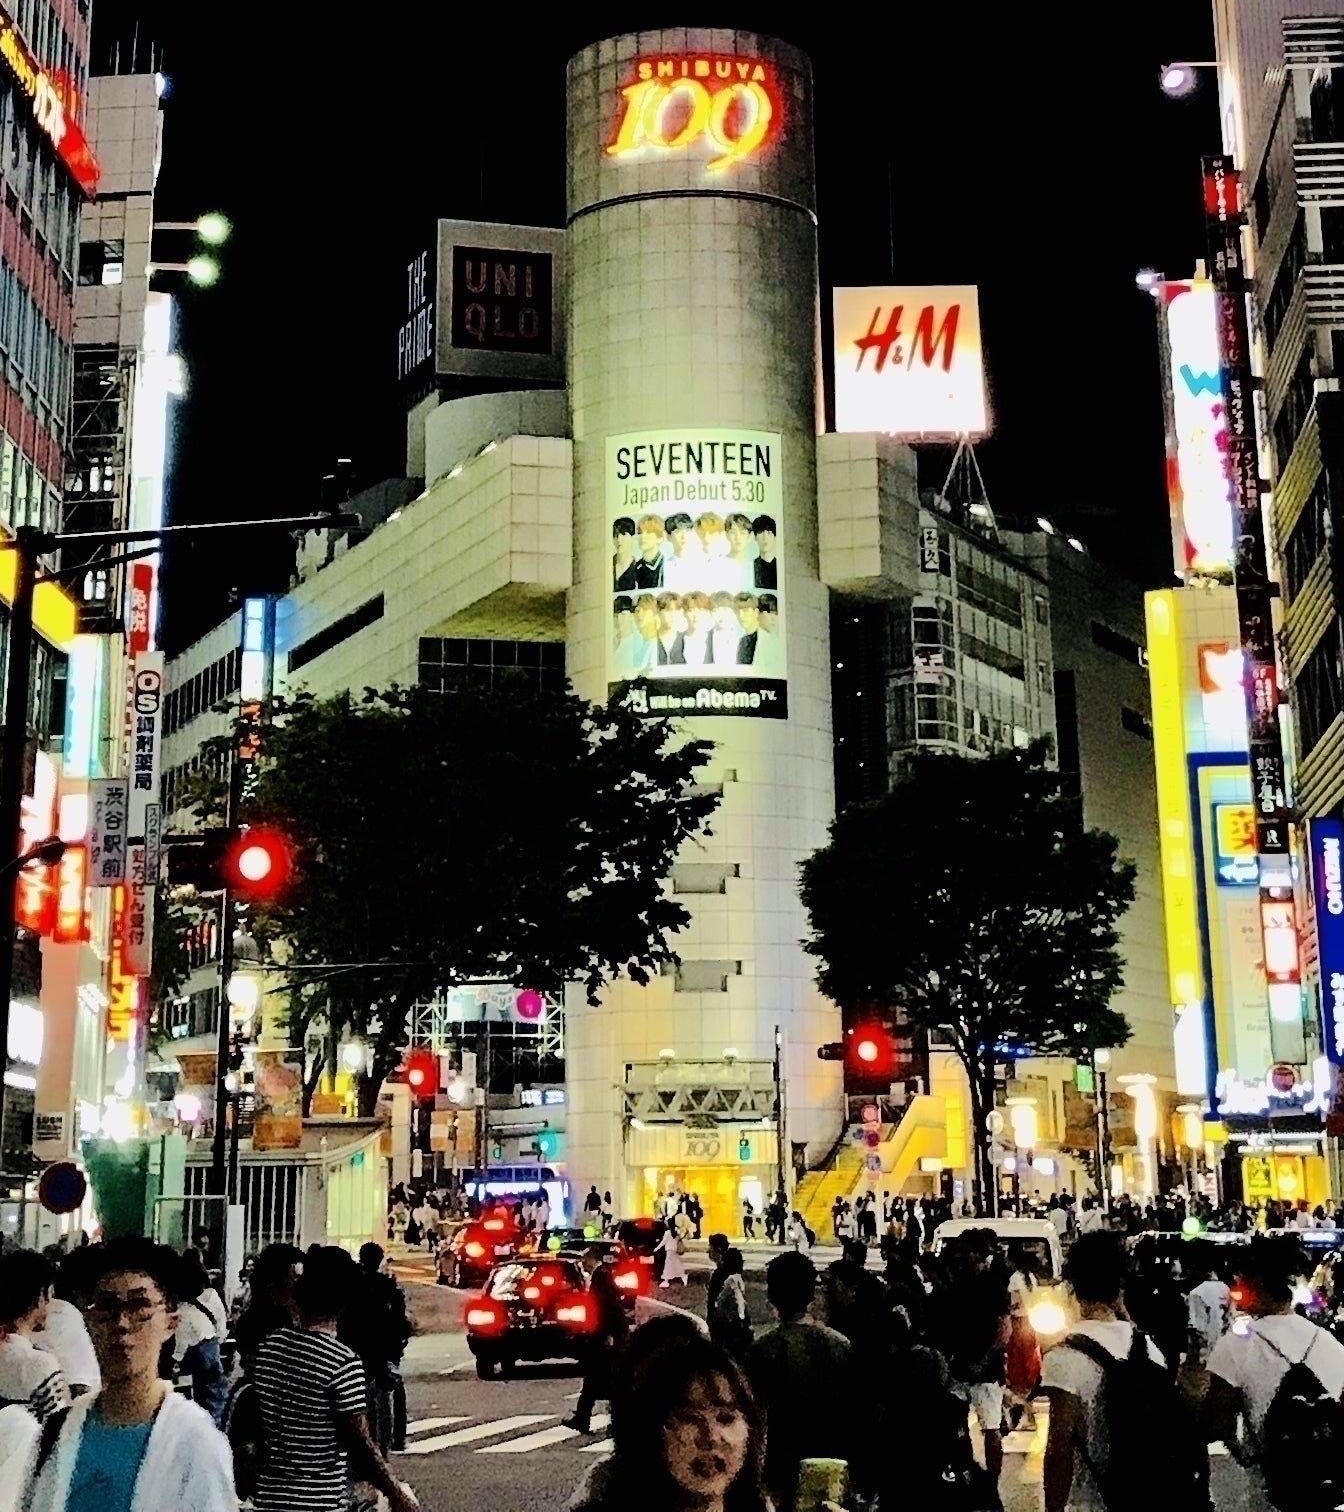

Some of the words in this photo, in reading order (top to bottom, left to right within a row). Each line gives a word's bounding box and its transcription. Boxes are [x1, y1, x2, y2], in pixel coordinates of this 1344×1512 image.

[639, 60, 766, 82] SHIBUYA
[606, 78, 774, 172] 109
[408, 250, 429, 316] THE
[465, 260, 533, 298] UNI
[852, 304, 961, 375] H&M
[616, 442, 772, 481] SEVENTEEN
[623, 483, 670, 510] Japan
[674, 479, 727, 502] Debut
[731, 481, 766, 504] 5.30
[101, 787, 124, 879] 渋谷駅前
[684, 1141, 720, 1161] 109
